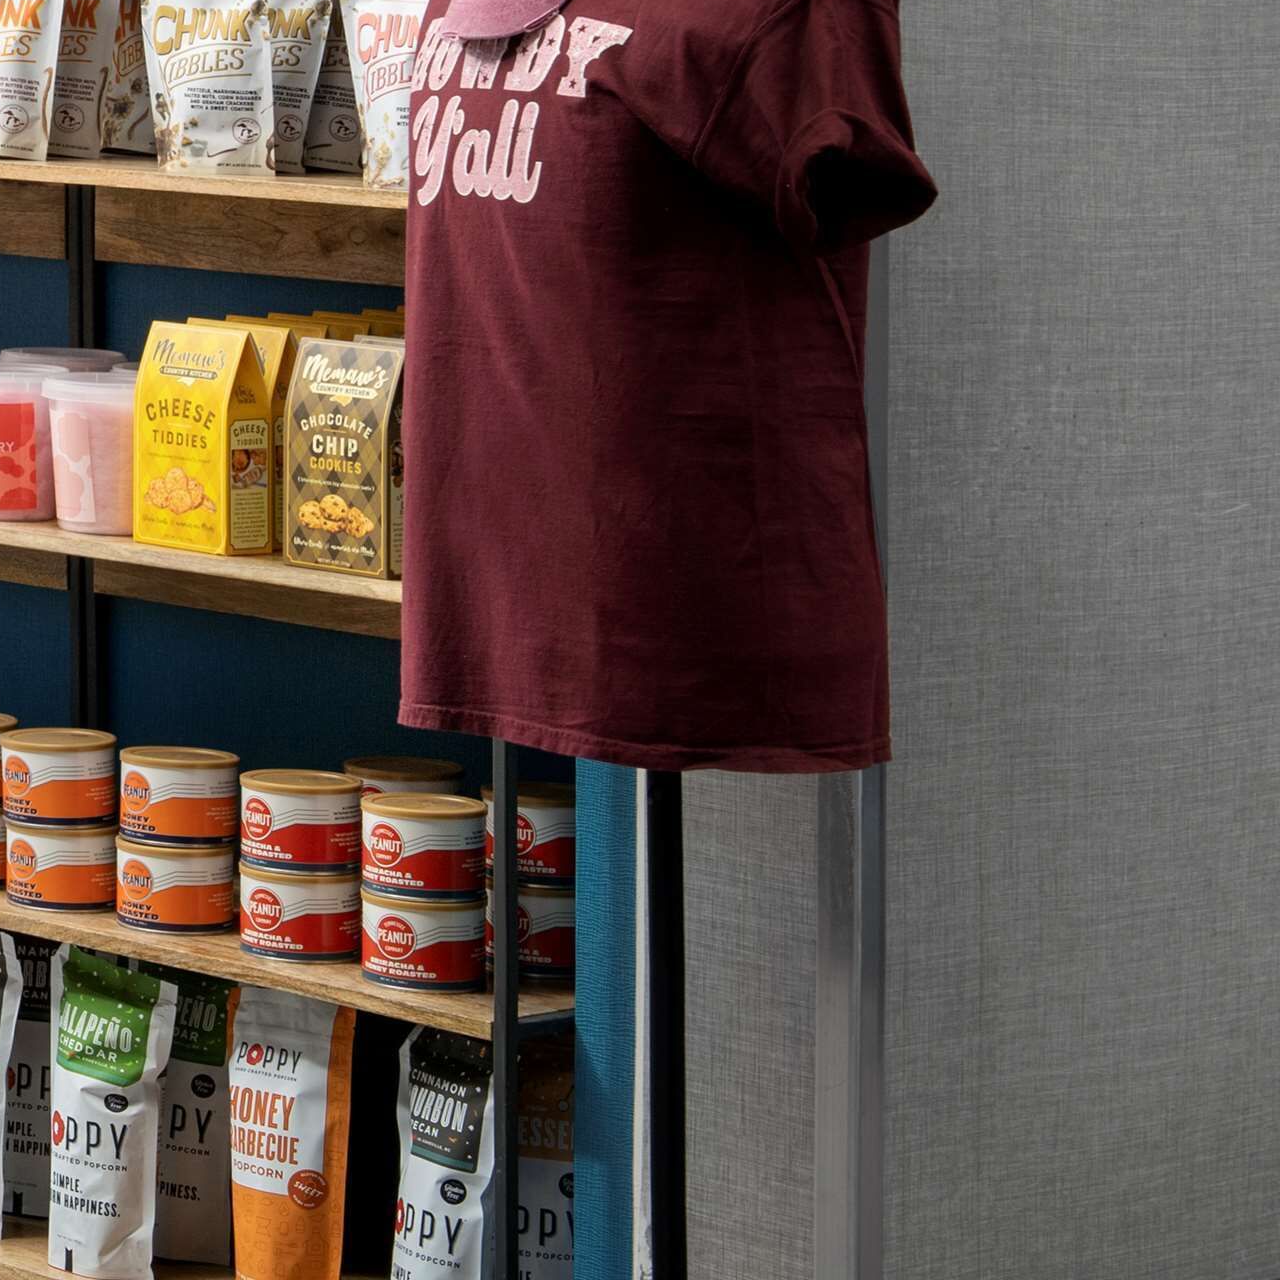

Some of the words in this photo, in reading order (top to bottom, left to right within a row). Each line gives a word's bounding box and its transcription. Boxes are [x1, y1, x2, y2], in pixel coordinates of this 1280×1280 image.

[152, 5, 251, 55] CHUNK
[411, 14, 633, 98] HOWDY
[412, 96, 542, 206] Y'all
[152, 338, 227, 370] Memaw's
[302, 353, 389, 389] Memaw's
[316, 384, 342, 394] COUNTRY
[344, 387, 371, 397] KITCHEN
[146, 398, 216, 431] CHEESE
[233, 423, 266, 438] CHEESE
[300, 413, 373, 440] CHOCOLATE
[152, 429, 208, 450] TIDDIES
[237, 437, 263, 446] TIDDIES
[312, 434, 358, 458] CHIP
[310, 456, 362, 475] COOKIES
[5, 768, 29, 782] PEANUT
[124, 784, 149, 799] PEANUT
[3, 801, 38, 815] ROASTED
[5, 796, 31, 806] HONEY
[121, 819, 156, 832] ROASTED
[122, 813, 150, 823] HONEY
[246, 811, 271, 827] PEANUT
[370, 836, 401, 853] PEANUT
[365, 864, 402, 878] SRIRACHA
[10, 879, 36, 890] HONEY
[380, 877, 424, 887] ROASTED
[249, 901, 281, 917] PEANUT
[260, 940, 303, 950] ROASTED
[377, 931, 413, 946] PEANUT
[370, 957, 414, 970] SRIRACHA
[388, 968, 437, 979] ROASTED
[59, 1034, 118, 1063] CHEDDAR
[237, 1041, 302, 1074] POPPY
[410, 1068, 467, 1097] CINNAMON
[231, 1085, 296, 1132] HONEY
[166, 1144, 210, 1156] POPCORN
[84, 1160, 128, 1172] POPCORN
[233, 1158, 284, 1180] POPCORN
[52, 1171, 83, 1194] SIMPLE.
[293, 1180, 324, 1198] SWEET
[64, 1193, 121, 1218] HAPPINESS.
[416, 1252, 461, 1269] POPCORN
